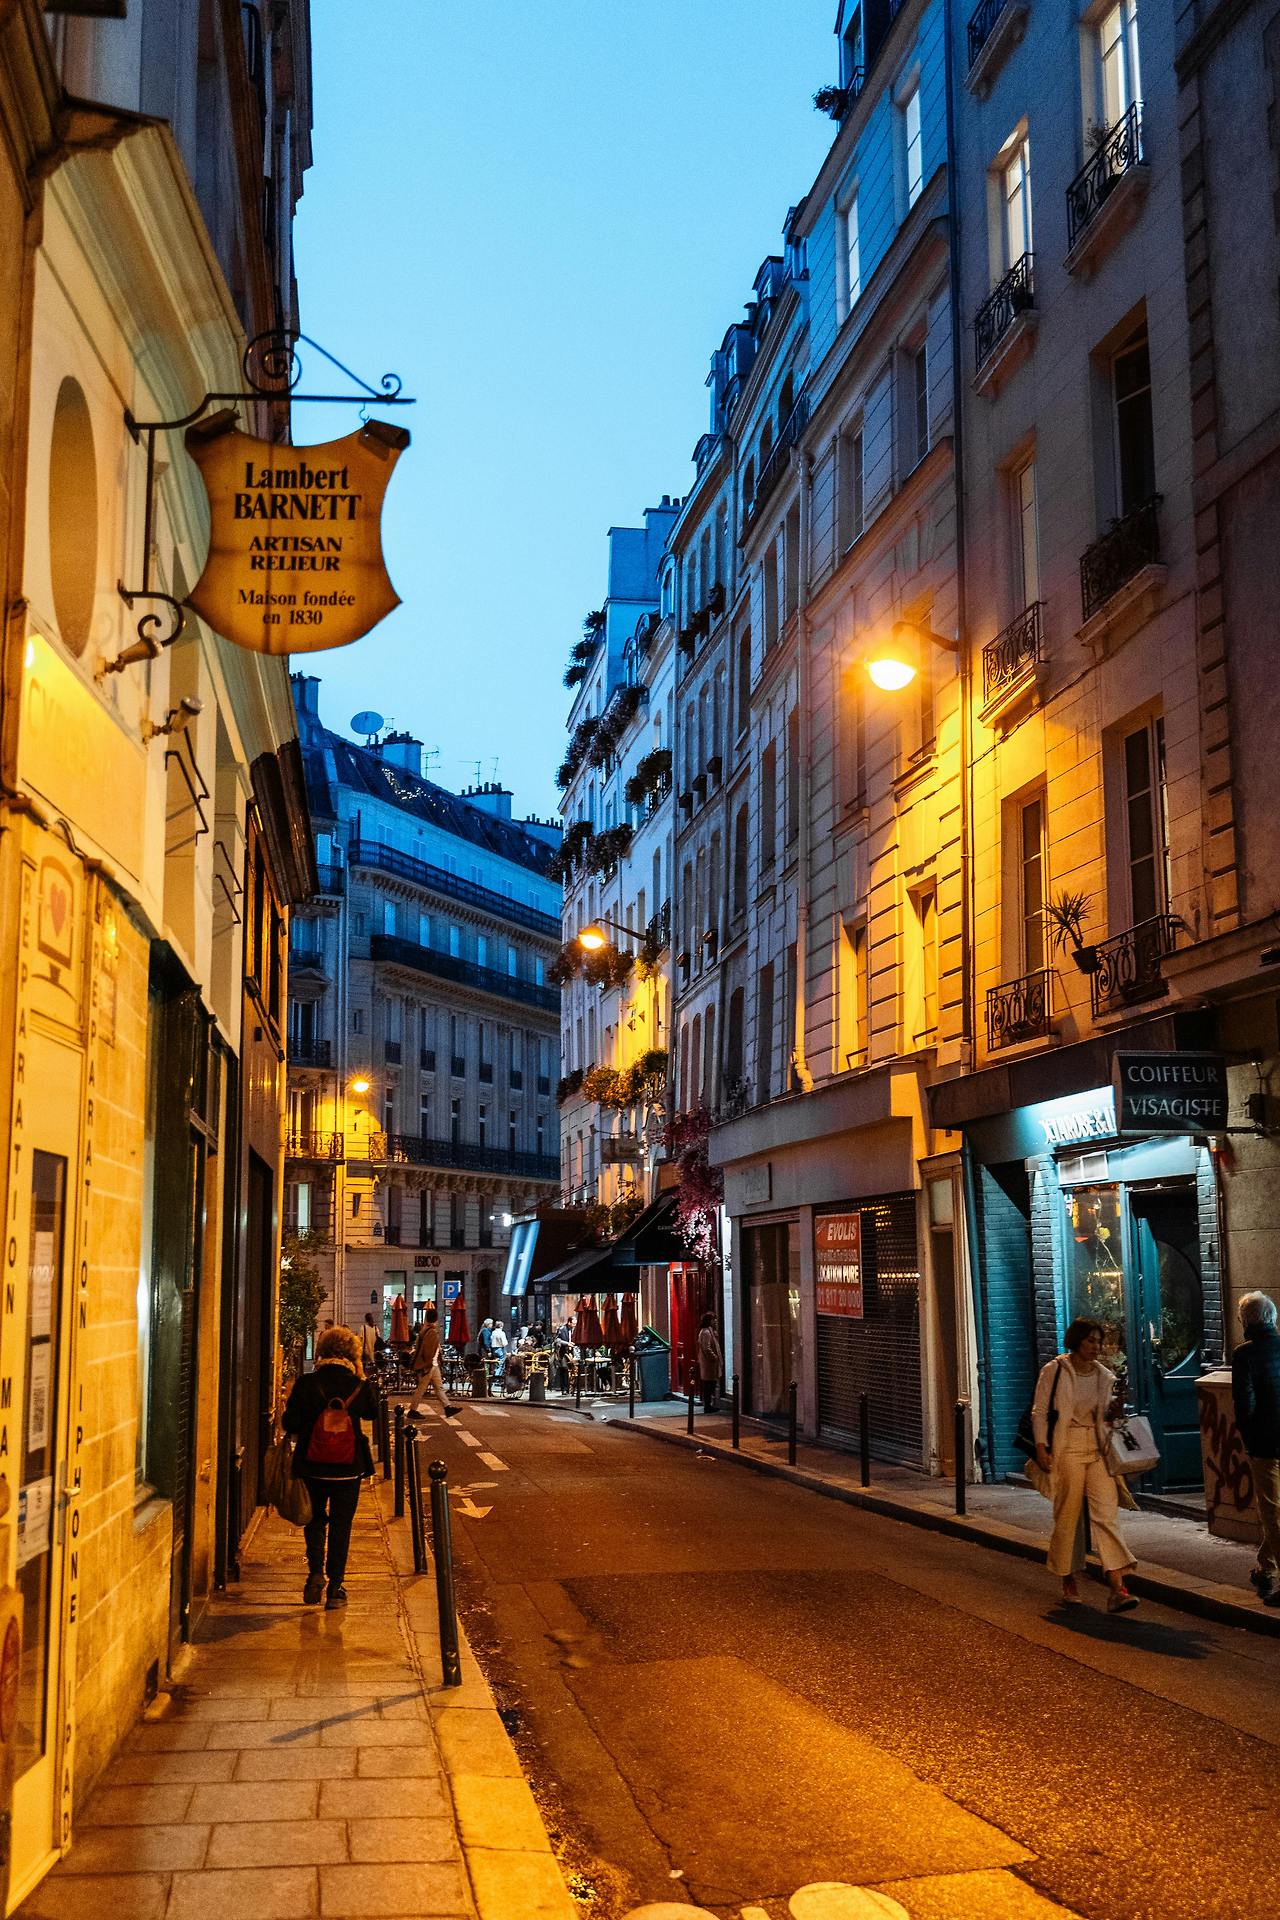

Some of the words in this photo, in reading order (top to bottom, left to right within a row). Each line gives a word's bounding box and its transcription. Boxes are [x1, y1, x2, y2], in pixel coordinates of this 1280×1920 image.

[245, 462, 349, 490] Lambert
[233, 492, 362, 520] BARNETT
[249, 536, 342, 551] ARTISAN
[250, 555, 340, 571] RELIEUR
[238, 589, 297, 606] Maison
[303, 590, 356, 606] fondée
[262, 613, 281, 625] en
[289, 610, 323, 625] 1830
[1127, 1065, 1219, 1083] COIFFEUR
[1129, 1098, 1221, 1117] VISAGISTE
[827, 1223, 857, 1241] EVOLIS
[817, 1265, 842, 1284] LOCATION
[843, 1265, 860, 1283] PURE
[447, 1285, 455, 1296] P
